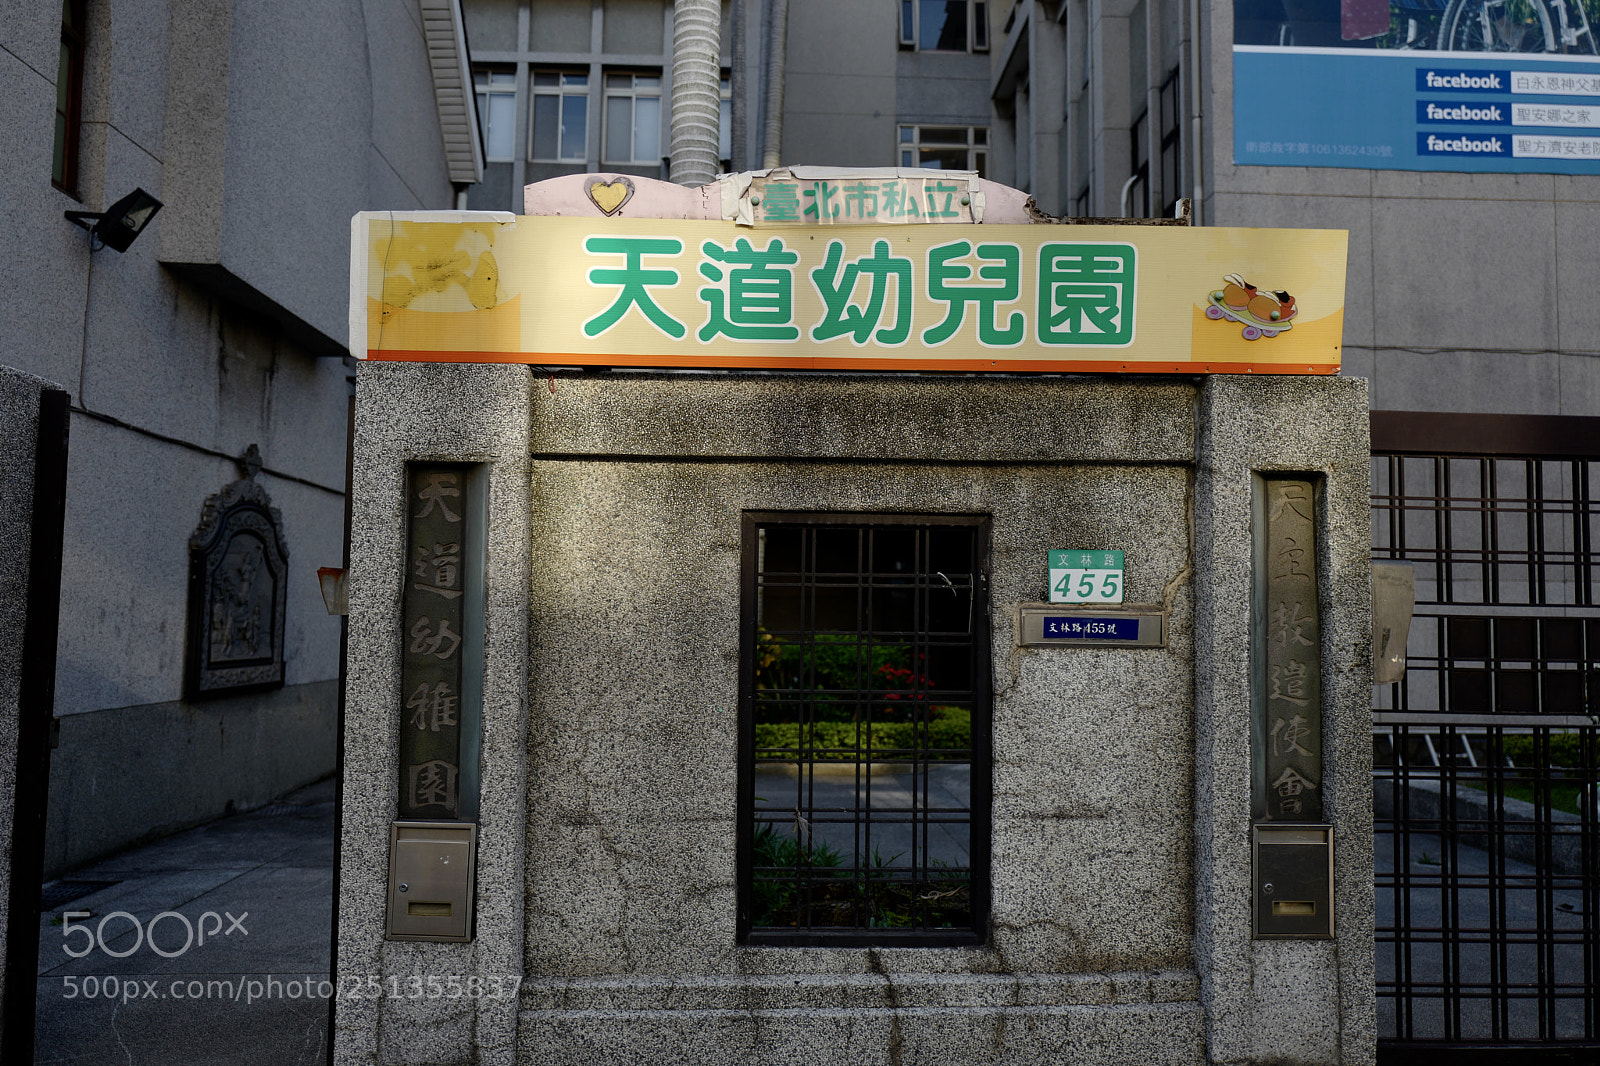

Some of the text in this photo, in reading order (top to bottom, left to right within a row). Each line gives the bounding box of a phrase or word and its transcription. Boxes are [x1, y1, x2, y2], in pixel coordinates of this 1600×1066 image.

[1426, 71, 1501, 89] facebook
[1426, 103, 1502, 121] facebook
[1516, 107, 1591, 124] 聖安娜之家
[1427, 135, 1502, 153] facebook
[763, 181, 959, 221] 臺北市私立
[582, 236, 1137, 348] 天道幼兒園
[1058, 553, 1115, 567] 文林路
[1054, 573, 1120, 598] 455
